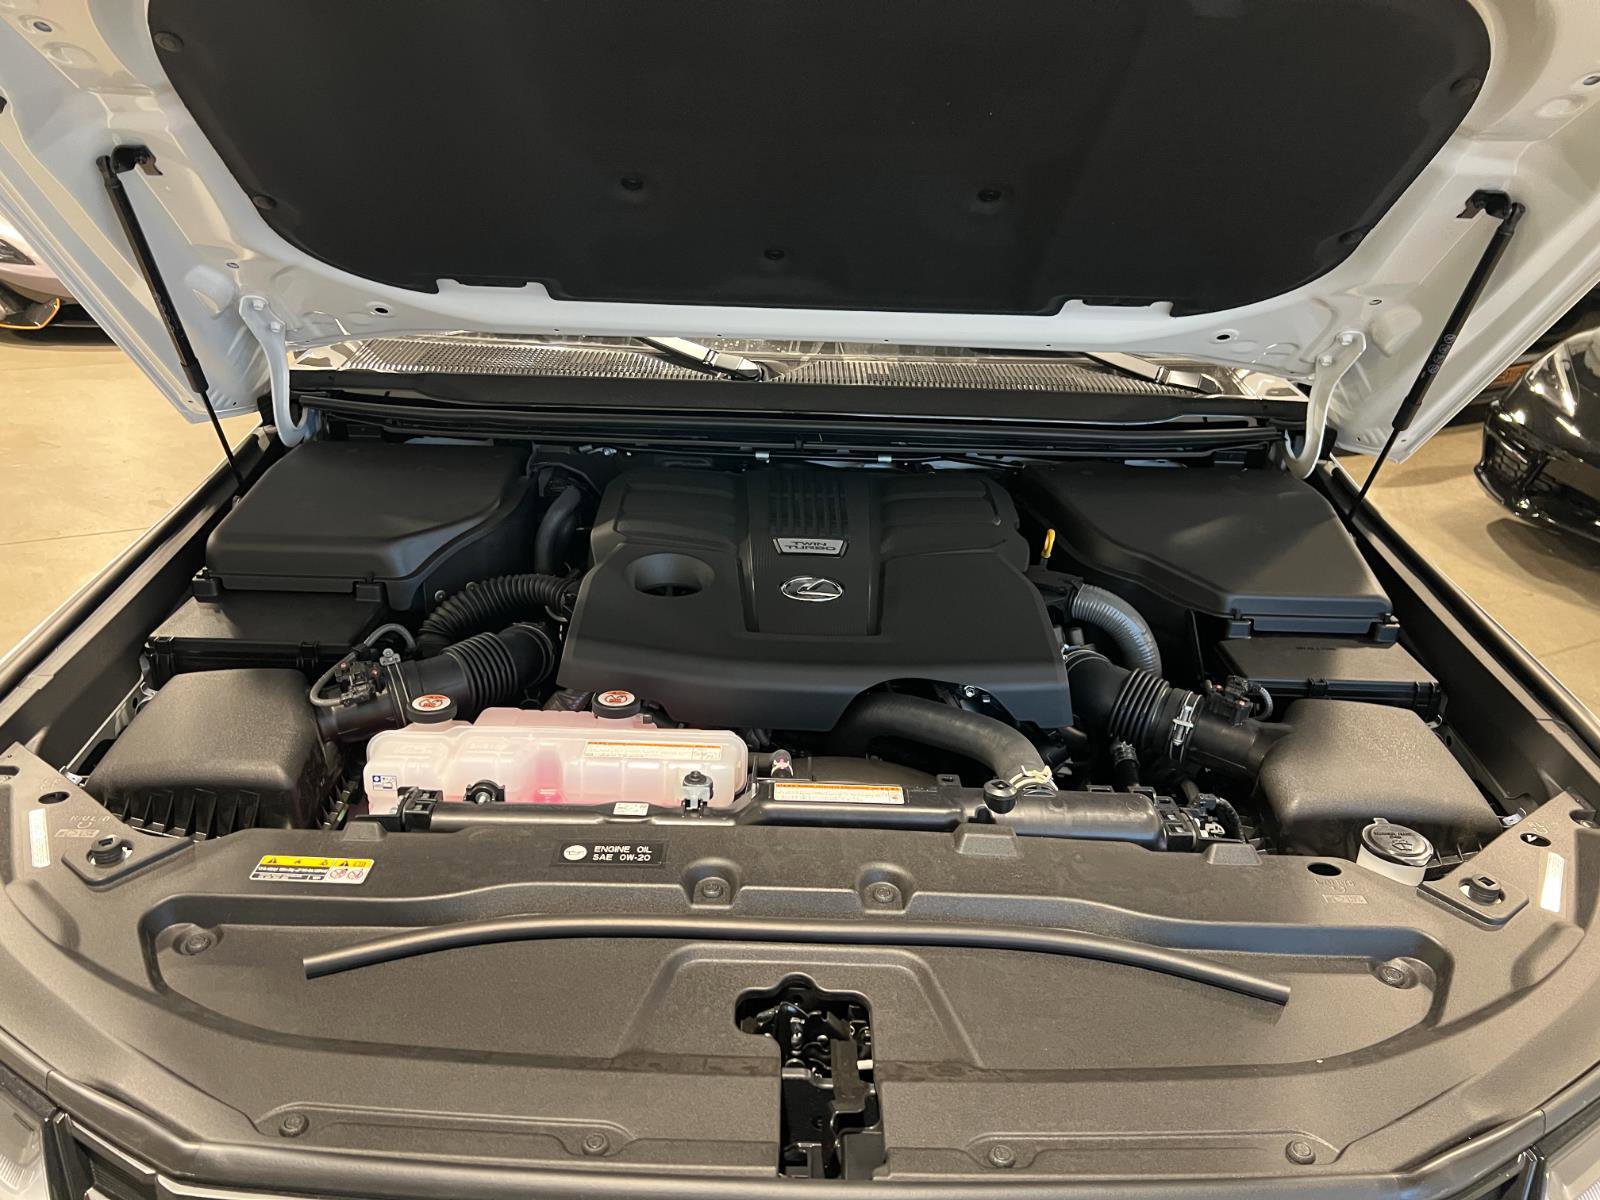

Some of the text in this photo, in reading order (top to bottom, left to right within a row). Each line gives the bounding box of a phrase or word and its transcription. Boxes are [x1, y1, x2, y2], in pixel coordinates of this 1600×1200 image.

[593, 845, 652, 853] ENGINE OIL
[592, 853, 651, 861] SAE 0W-20
